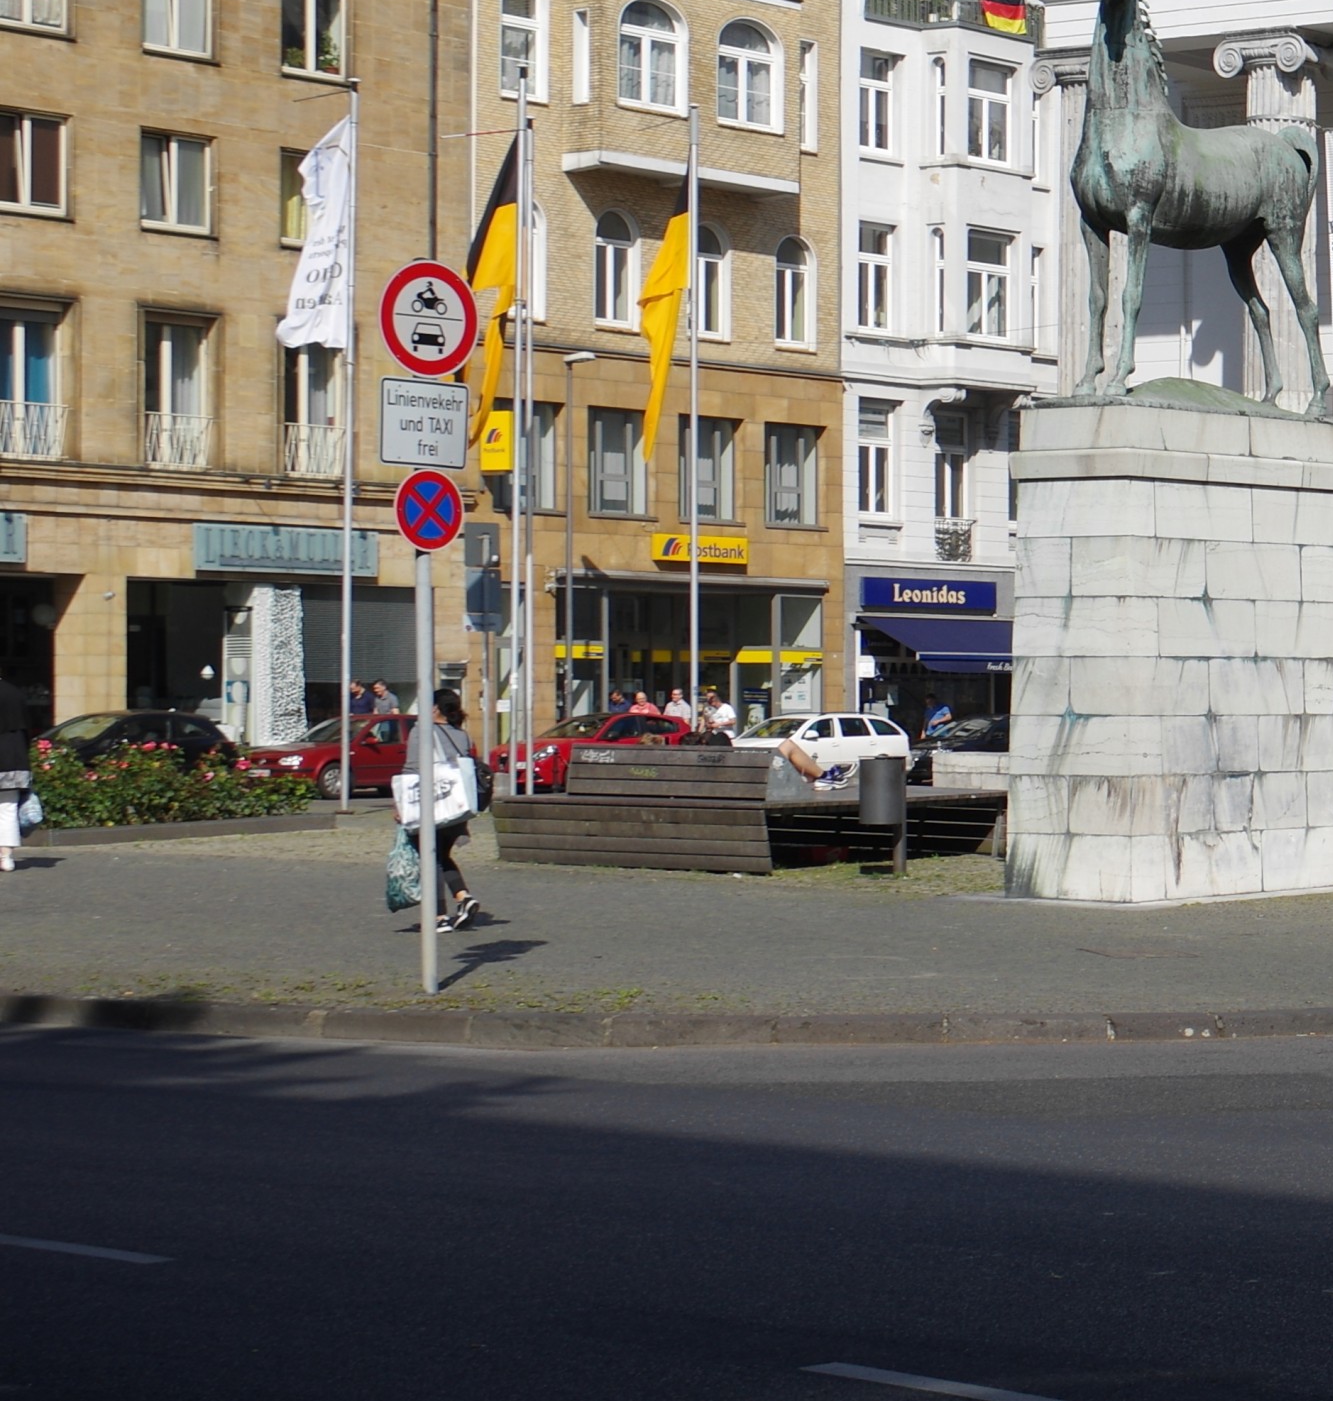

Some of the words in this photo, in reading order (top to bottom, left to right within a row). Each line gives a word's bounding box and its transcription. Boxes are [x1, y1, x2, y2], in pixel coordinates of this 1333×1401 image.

[387, 388, 463, 412] Linienvekehr
[400, 417, 423, 432] und
[428, 416, 453, 435] TAXI
[418, 439, 439, 457] frei
[893, 583, 966, 604] Leonidas
